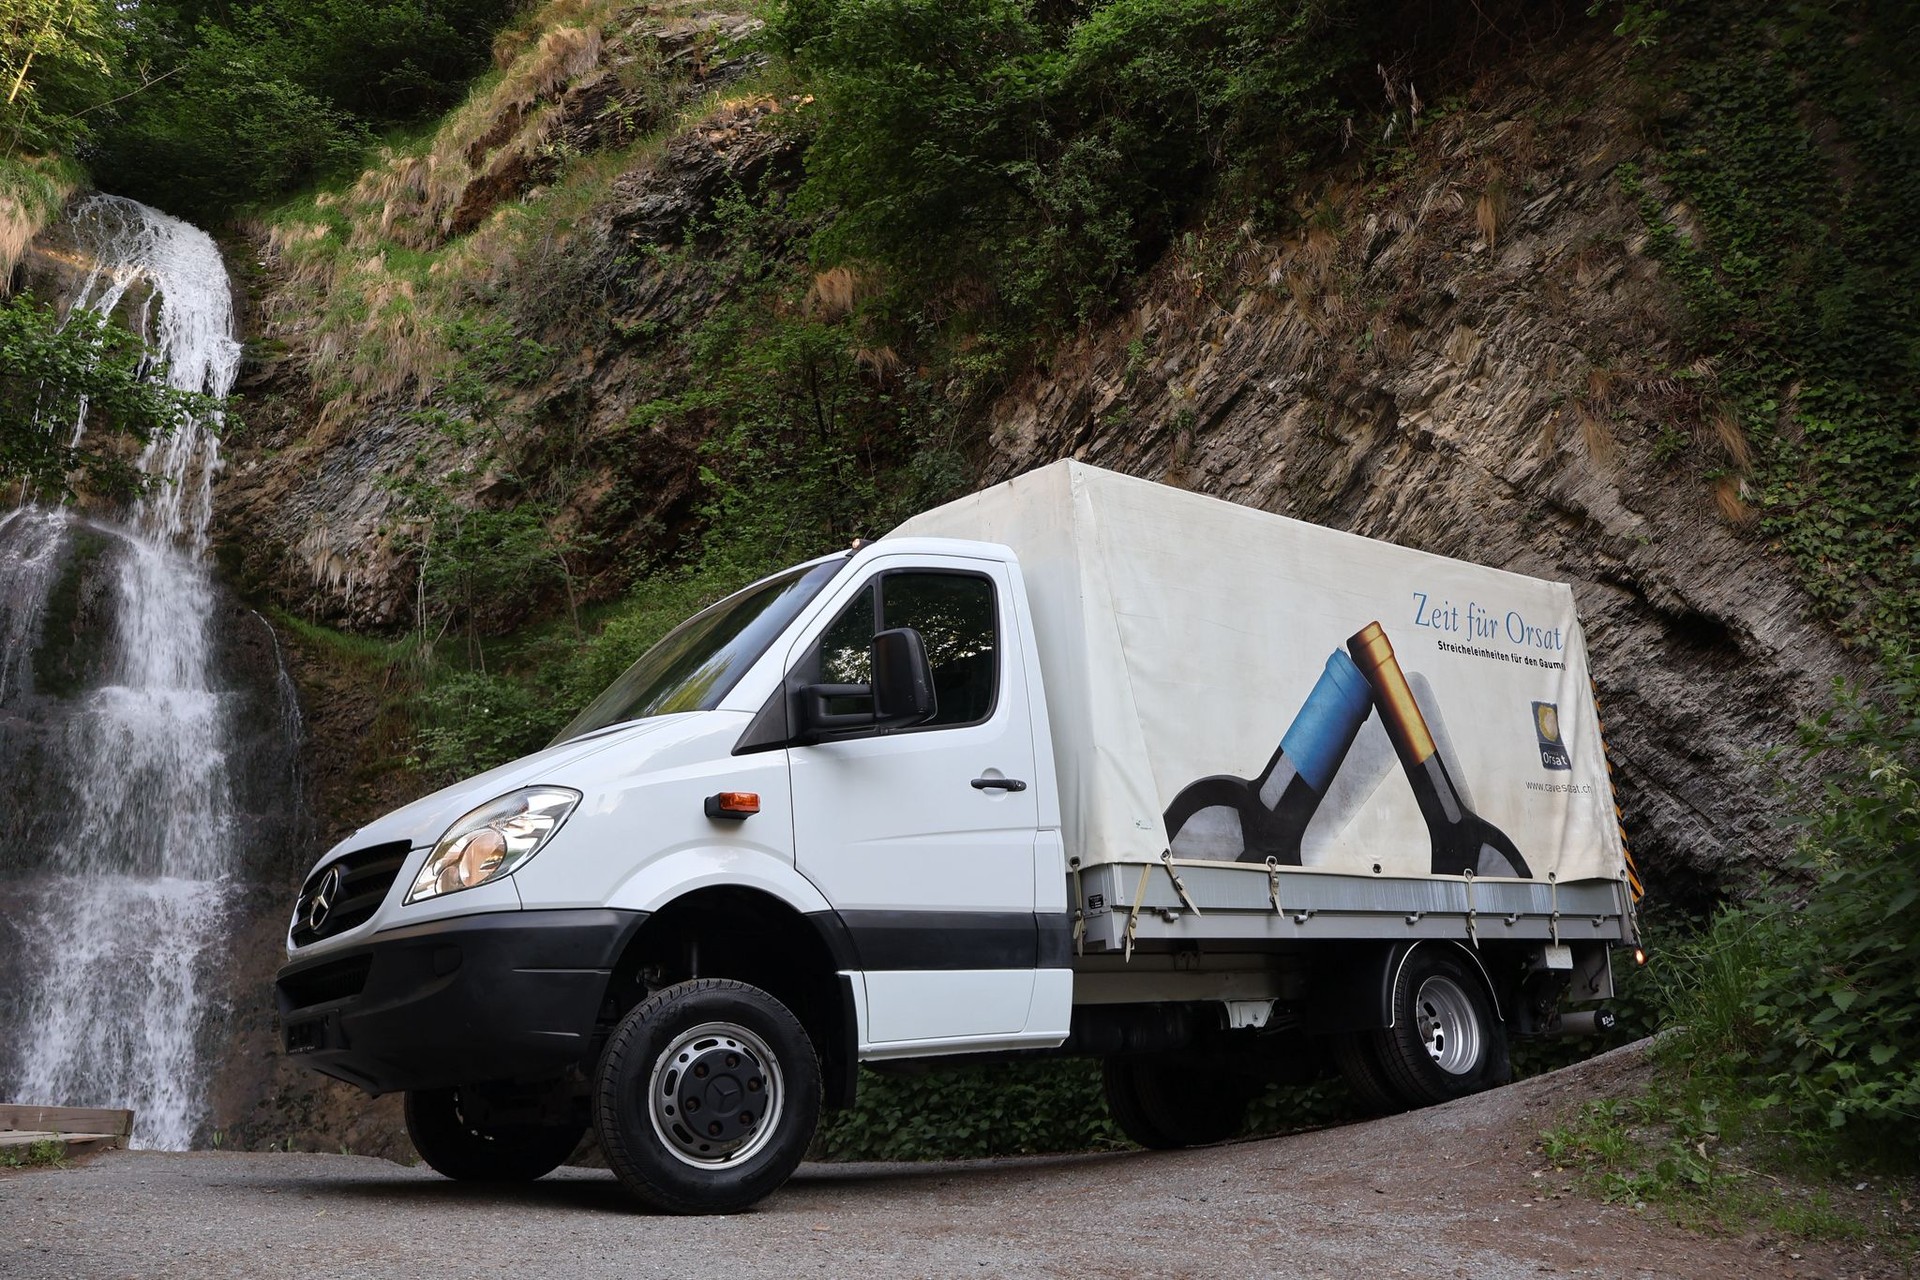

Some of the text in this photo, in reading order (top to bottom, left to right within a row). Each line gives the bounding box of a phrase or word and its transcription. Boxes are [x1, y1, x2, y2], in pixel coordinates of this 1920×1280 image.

[1413, 592, 1563, 650] Zeit für Orsat
[1437, 640, 1510, 662] Streicheleinheiten
[1511, 653, 1522, 664] für
[1524, 656, 1538, 667] den
[1543, 751, 1568, 766] Orsat
